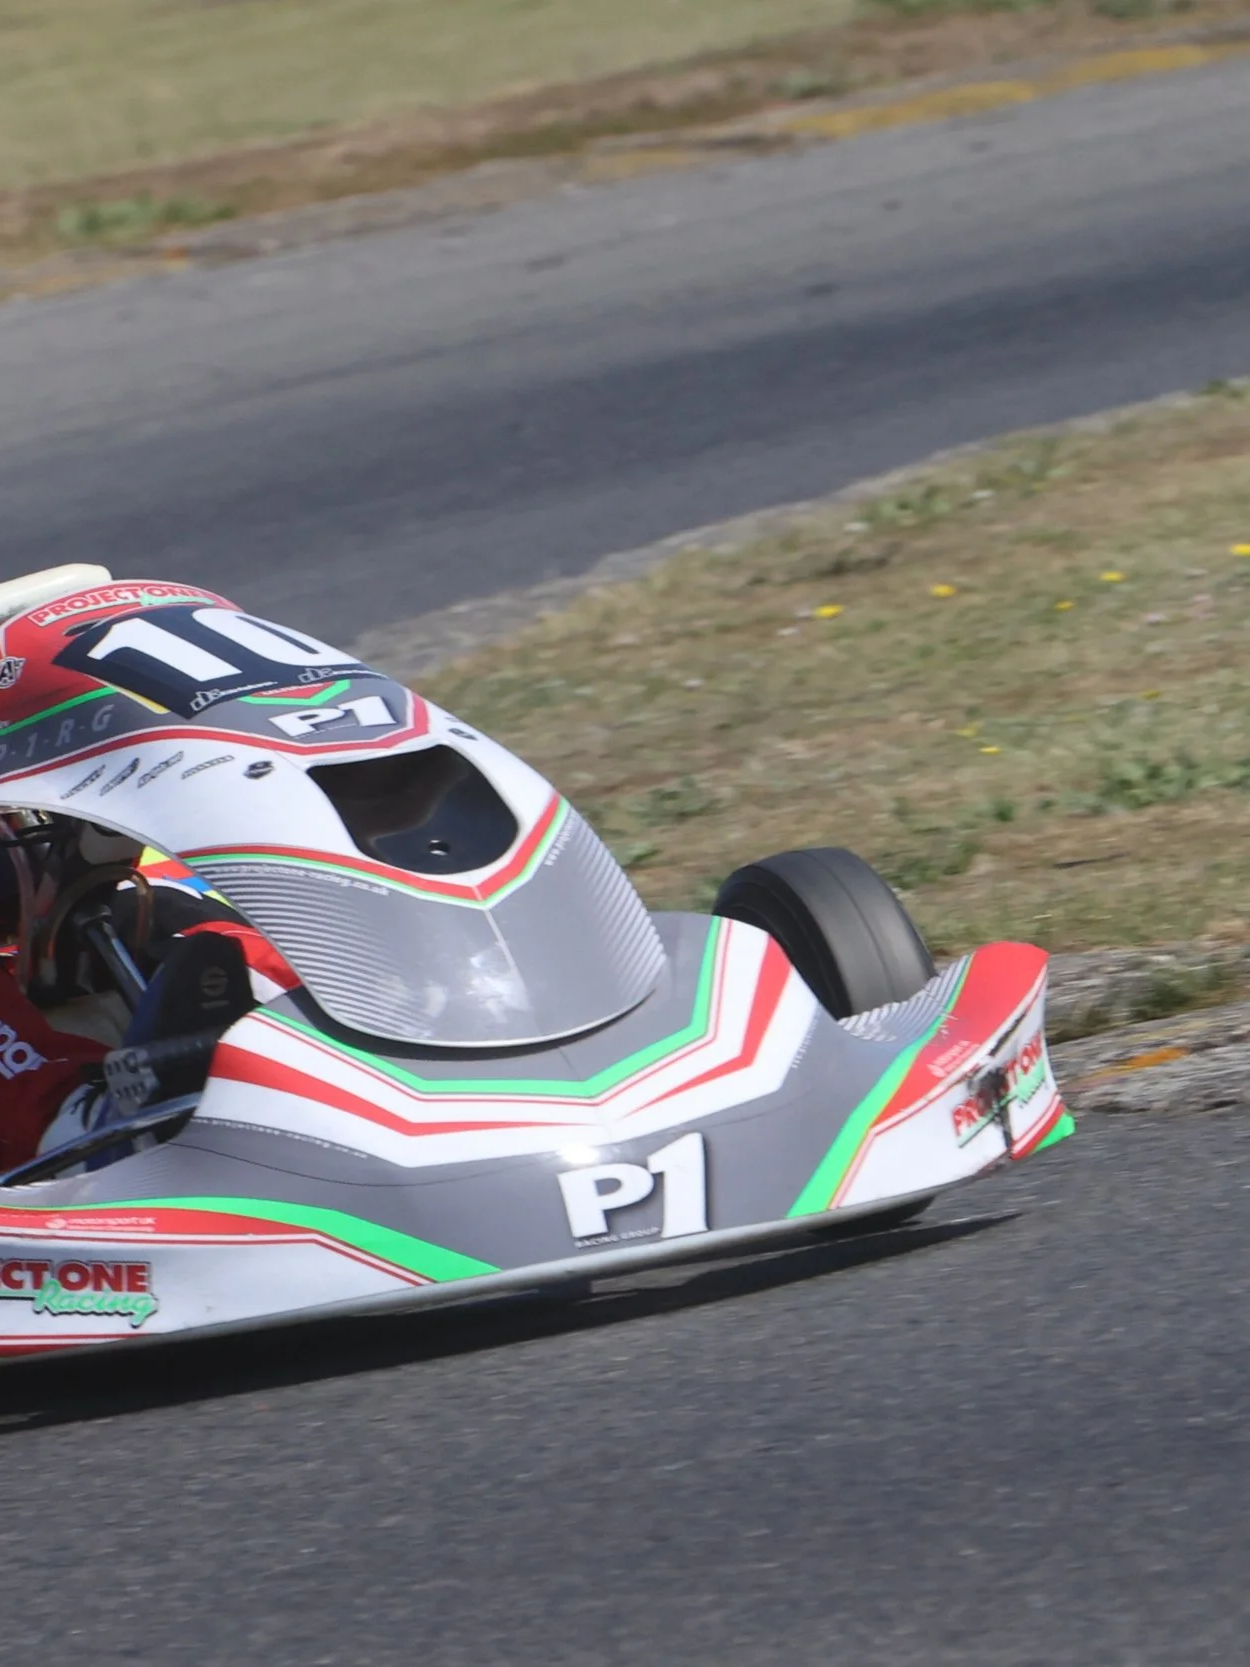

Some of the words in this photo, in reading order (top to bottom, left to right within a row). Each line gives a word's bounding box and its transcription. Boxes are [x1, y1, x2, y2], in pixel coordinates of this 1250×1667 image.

[35, 587, 141, 623] PROJECT
[86, 607, 372, 682] 10
[268, 696, 397, 738] P1
[556, 1131, 709, 1239] P1
[57, 1261, 148, 1293] ONE
[33, 1278, 157, 1327] Racing
